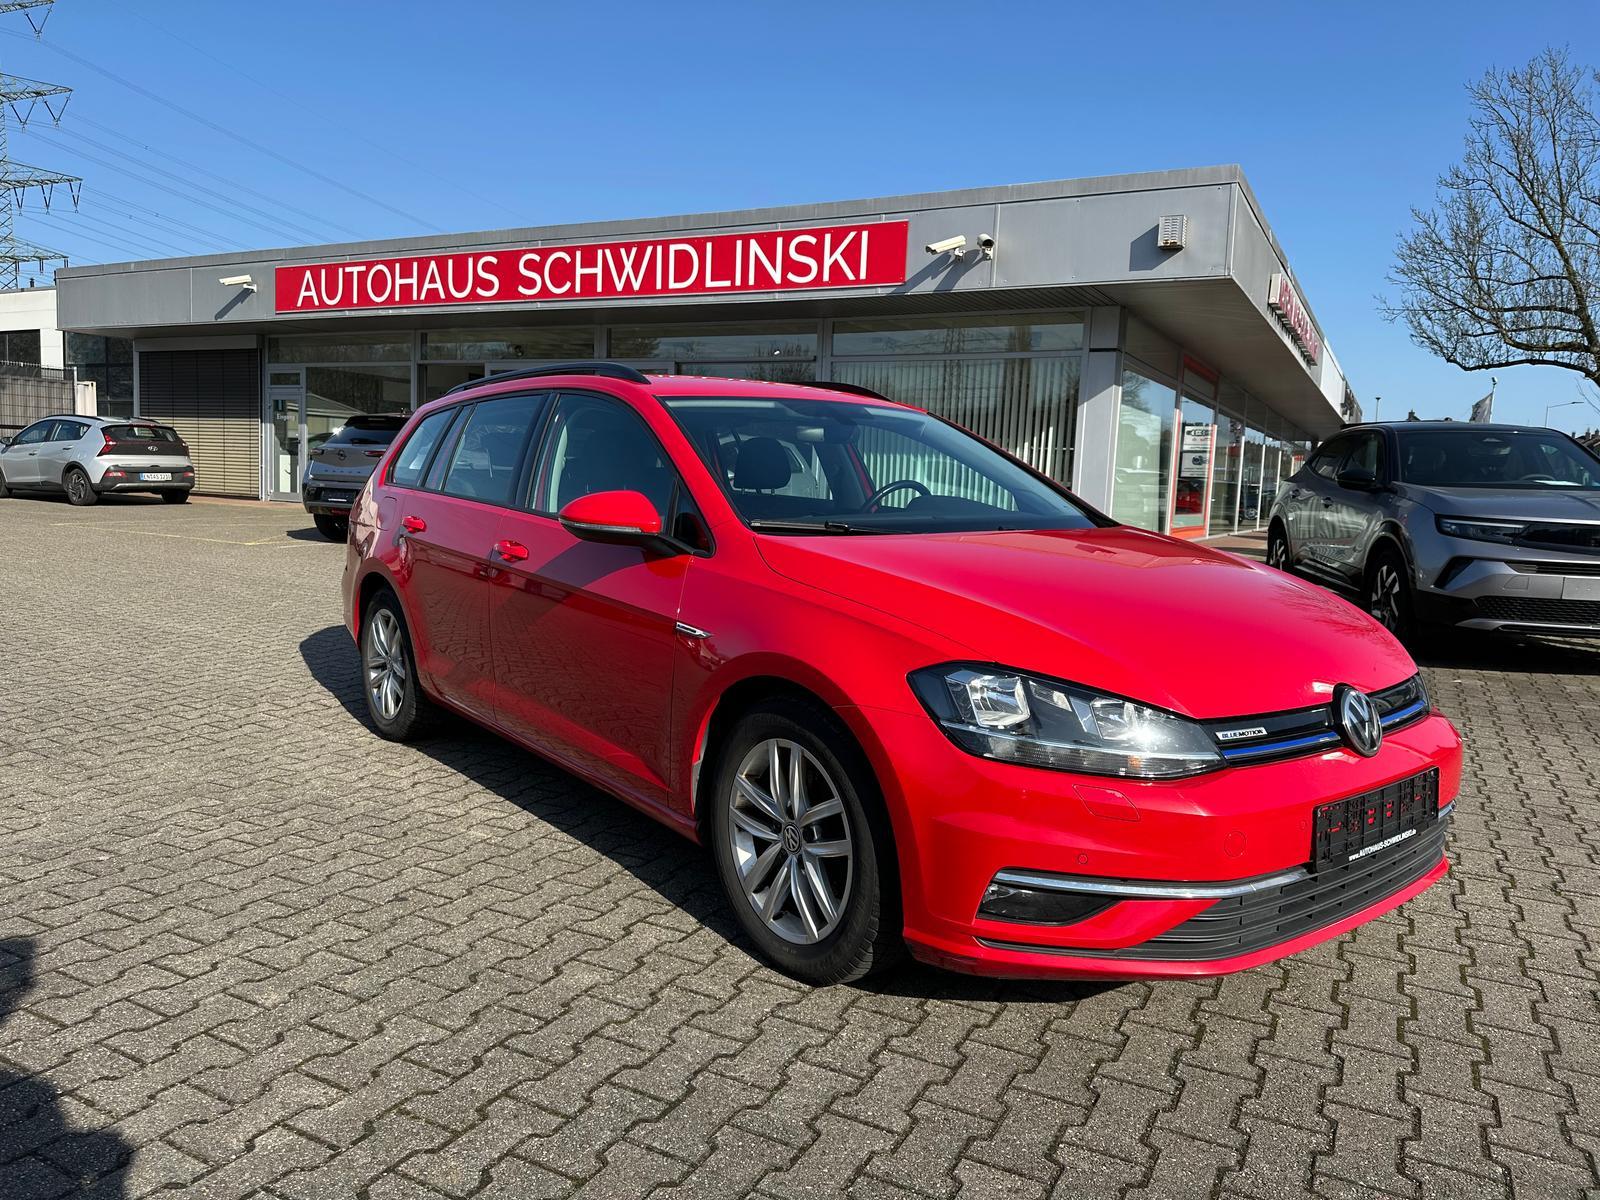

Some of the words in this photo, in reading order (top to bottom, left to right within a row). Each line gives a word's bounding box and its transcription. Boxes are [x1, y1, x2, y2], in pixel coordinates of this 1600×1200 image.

[296, 255, 501, 308] AUTOHAUS
[517, 230, 869, 297] SCHWIDLINSKI
[1220, 728, 1265, 739] BLUEMOTION
